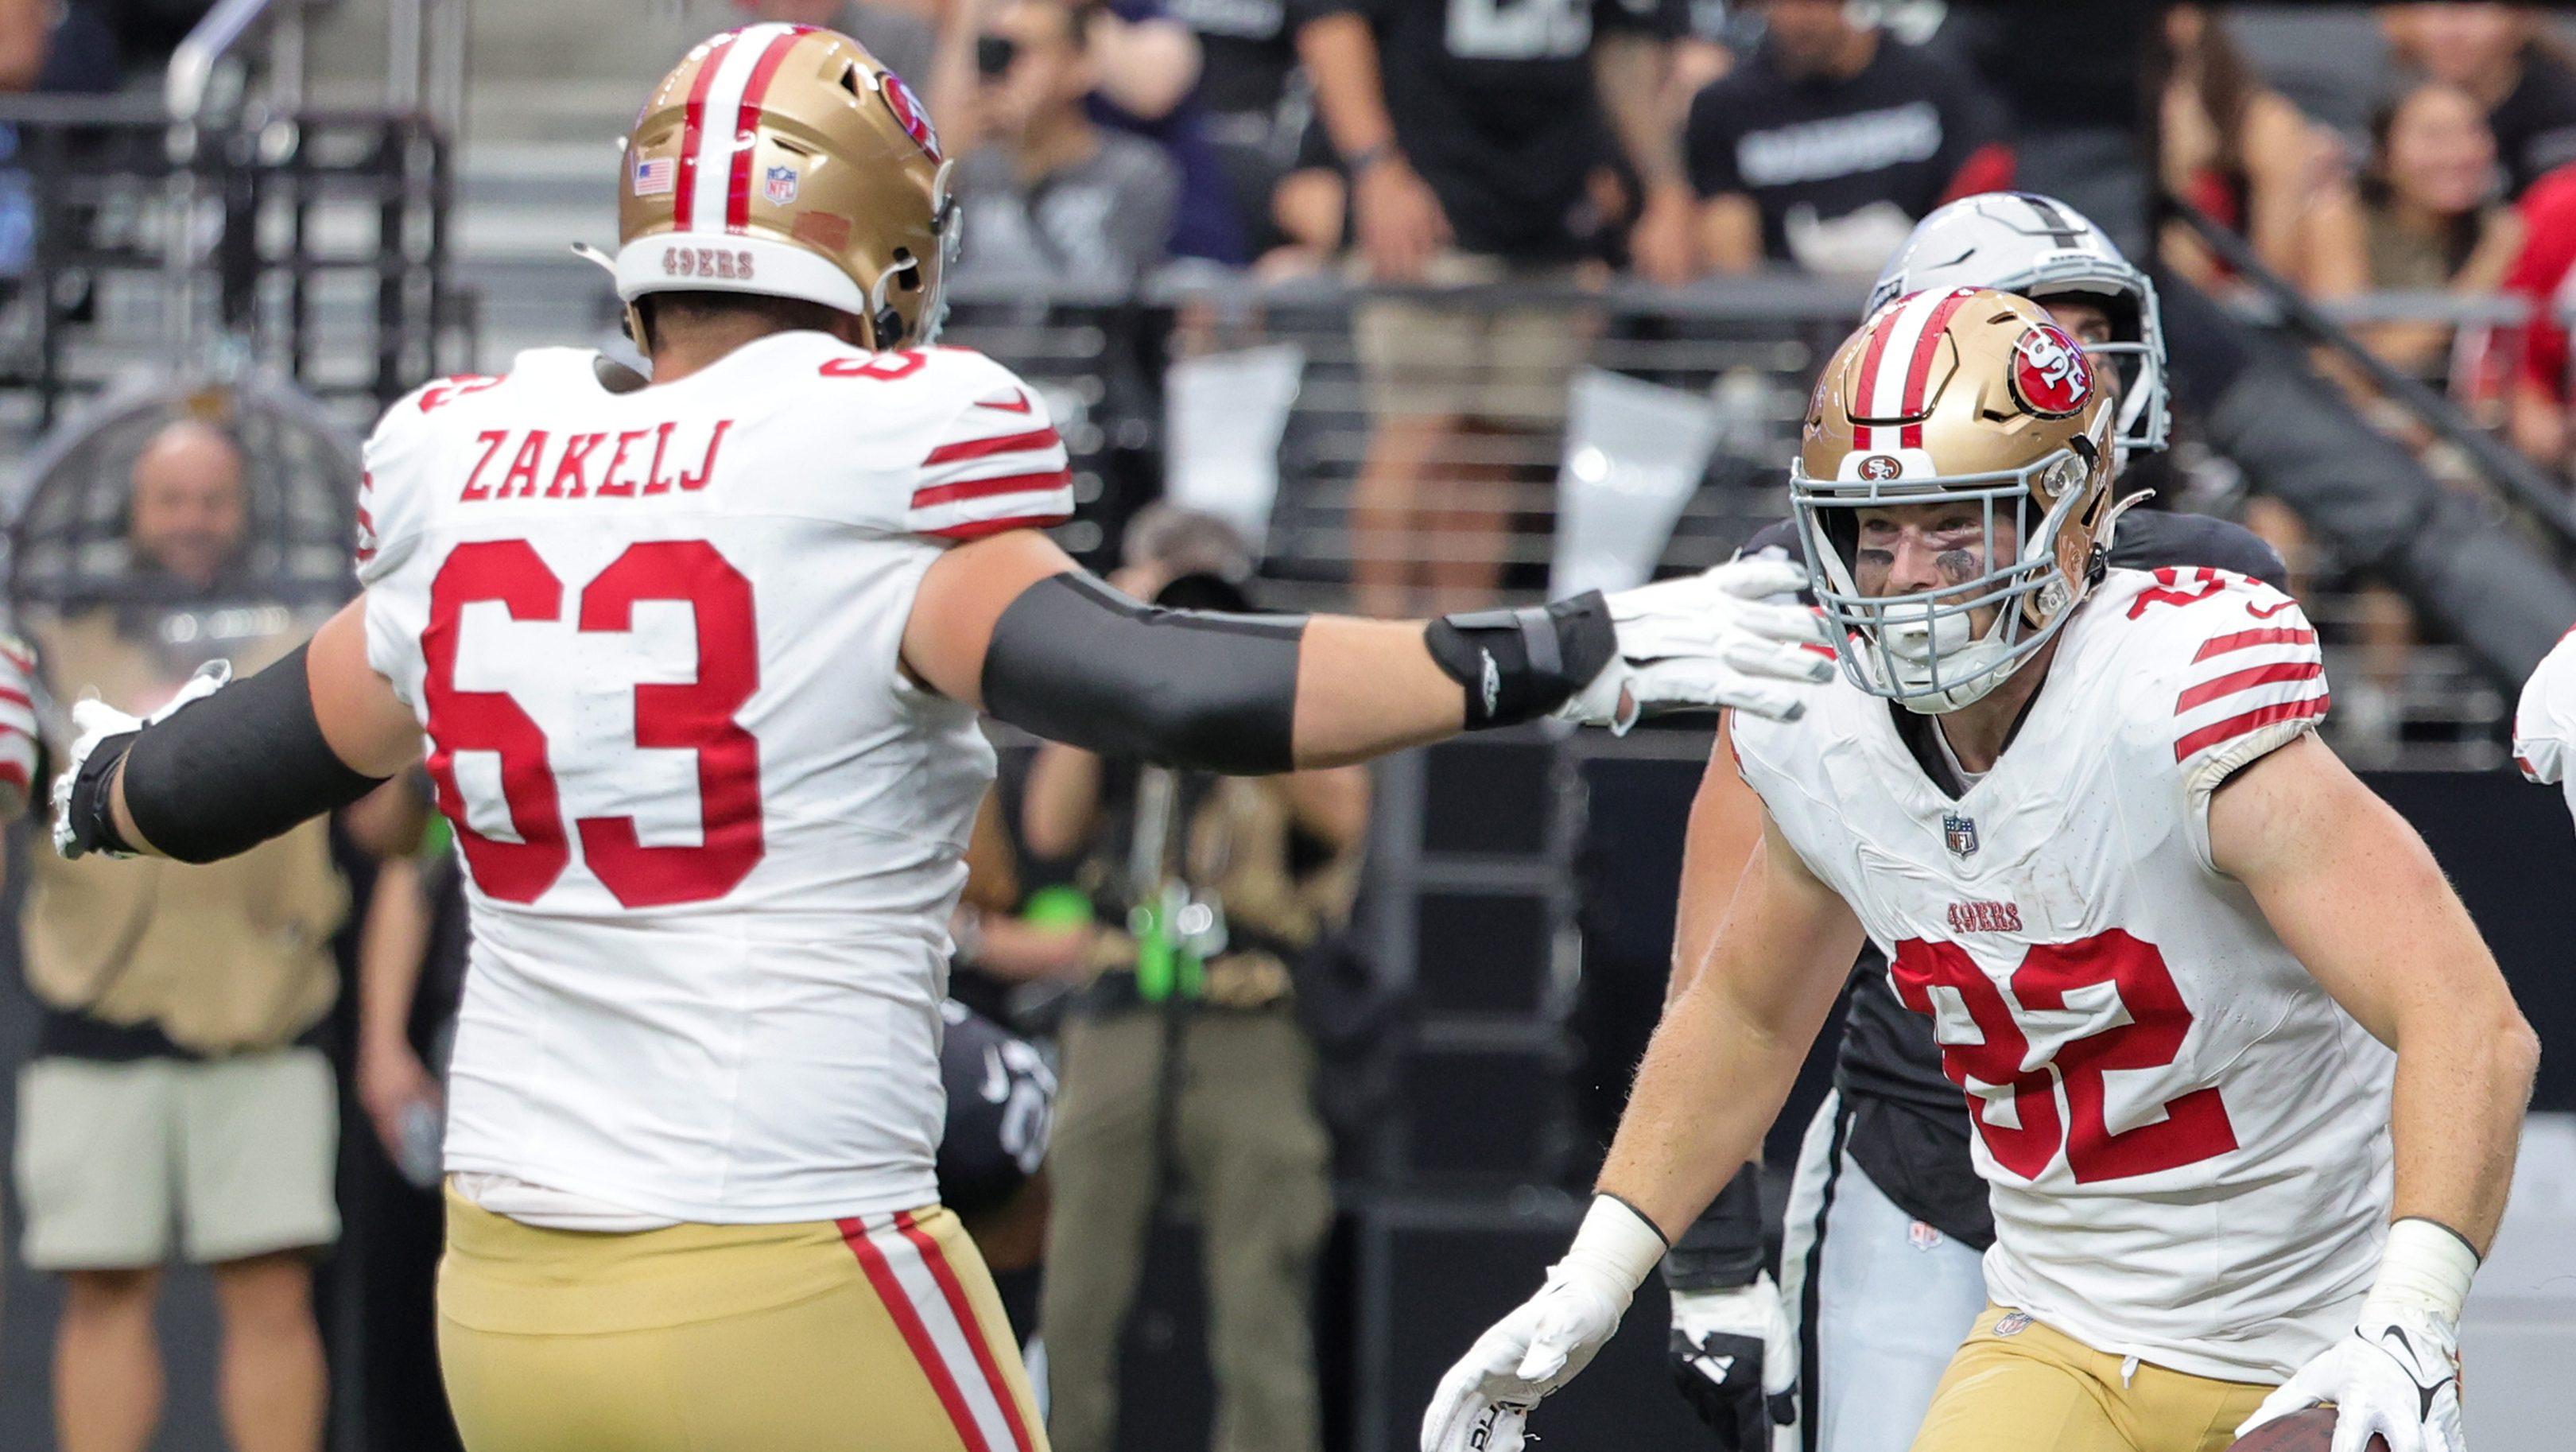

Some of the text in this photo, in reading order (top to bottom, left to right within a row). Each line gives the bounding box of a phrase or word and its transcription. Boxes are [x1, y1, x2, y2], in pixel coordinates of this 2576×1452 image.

[662, 246, 755, 280] 49ERS
[459, 419, 735, 503] ZAKELJ
[421, 538, 766, 909] 63
[1949, 833, 1973, 852] NFL
[1947, 900, 2023, 934] 49ERS
[1890, 927, 2240, 1184] 82
